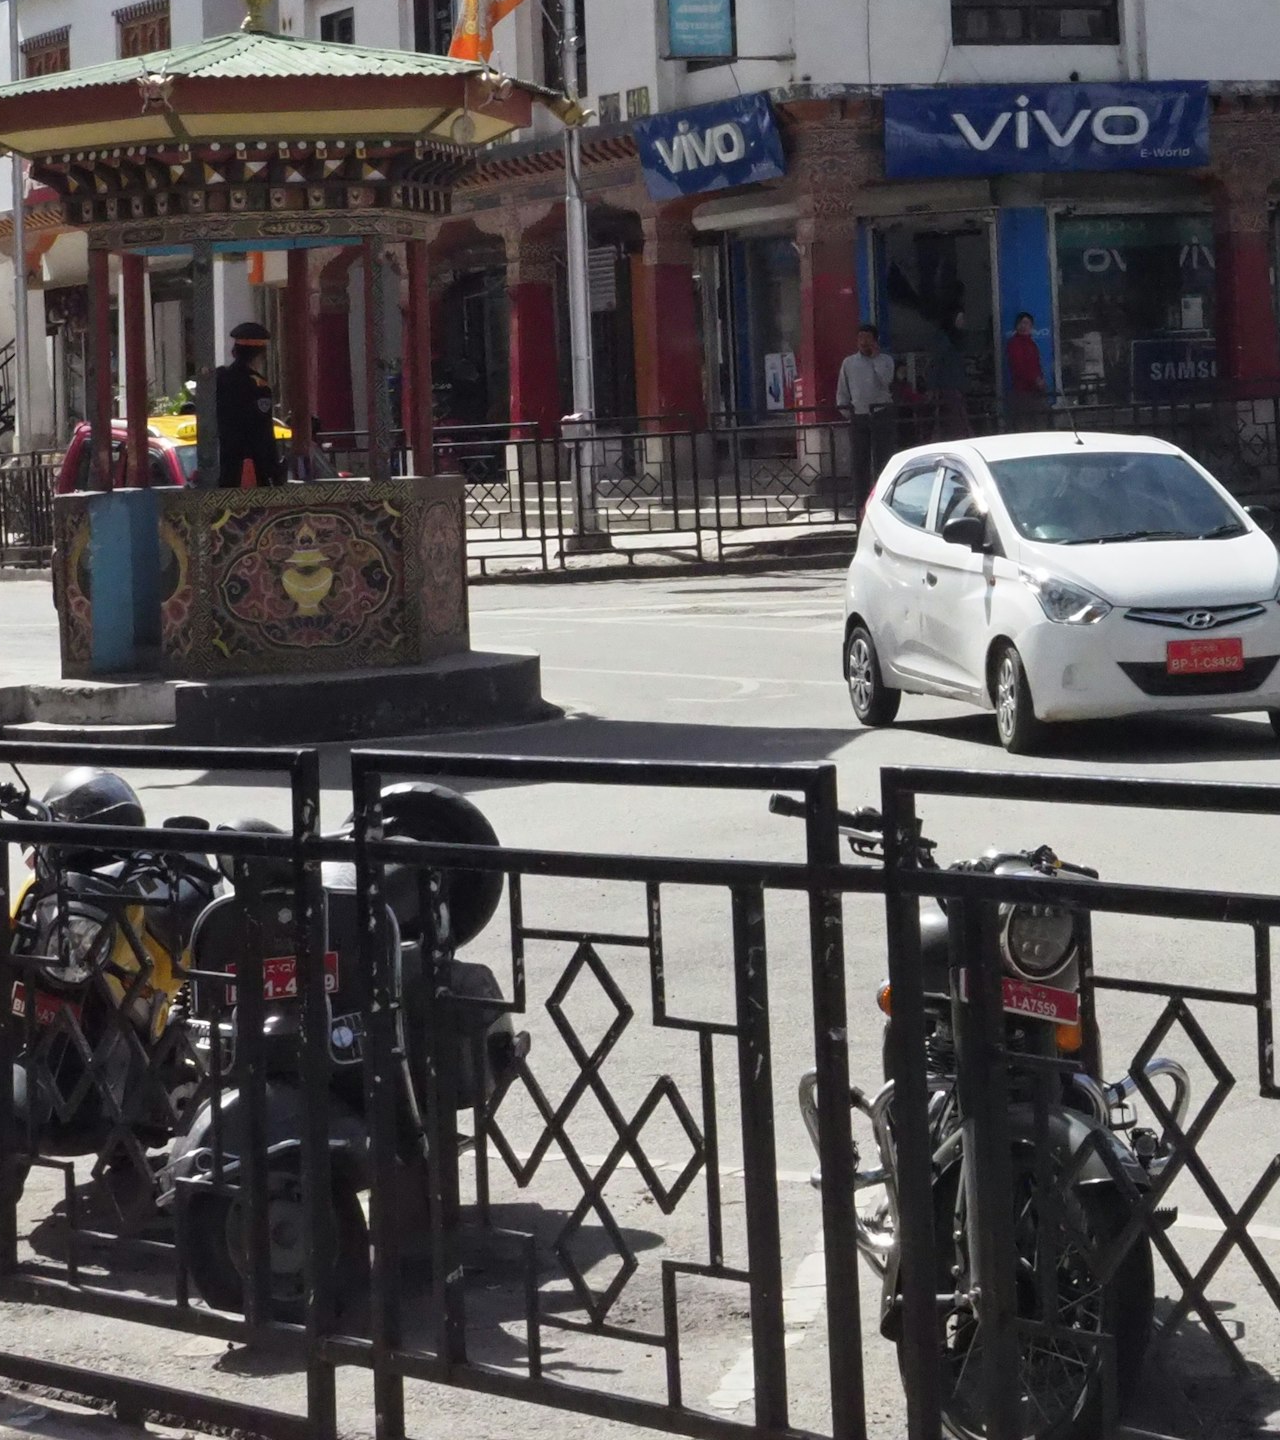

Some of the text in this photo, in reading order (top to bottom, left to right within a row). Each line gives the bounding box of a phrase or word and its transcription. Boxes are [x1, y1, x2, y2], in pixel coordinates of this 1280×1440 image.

[952, 94, 1150, 151] vivo
[1140, 147, 1191, 158] E-World
[1004, 995, 1058, 1017] -1-A7559
